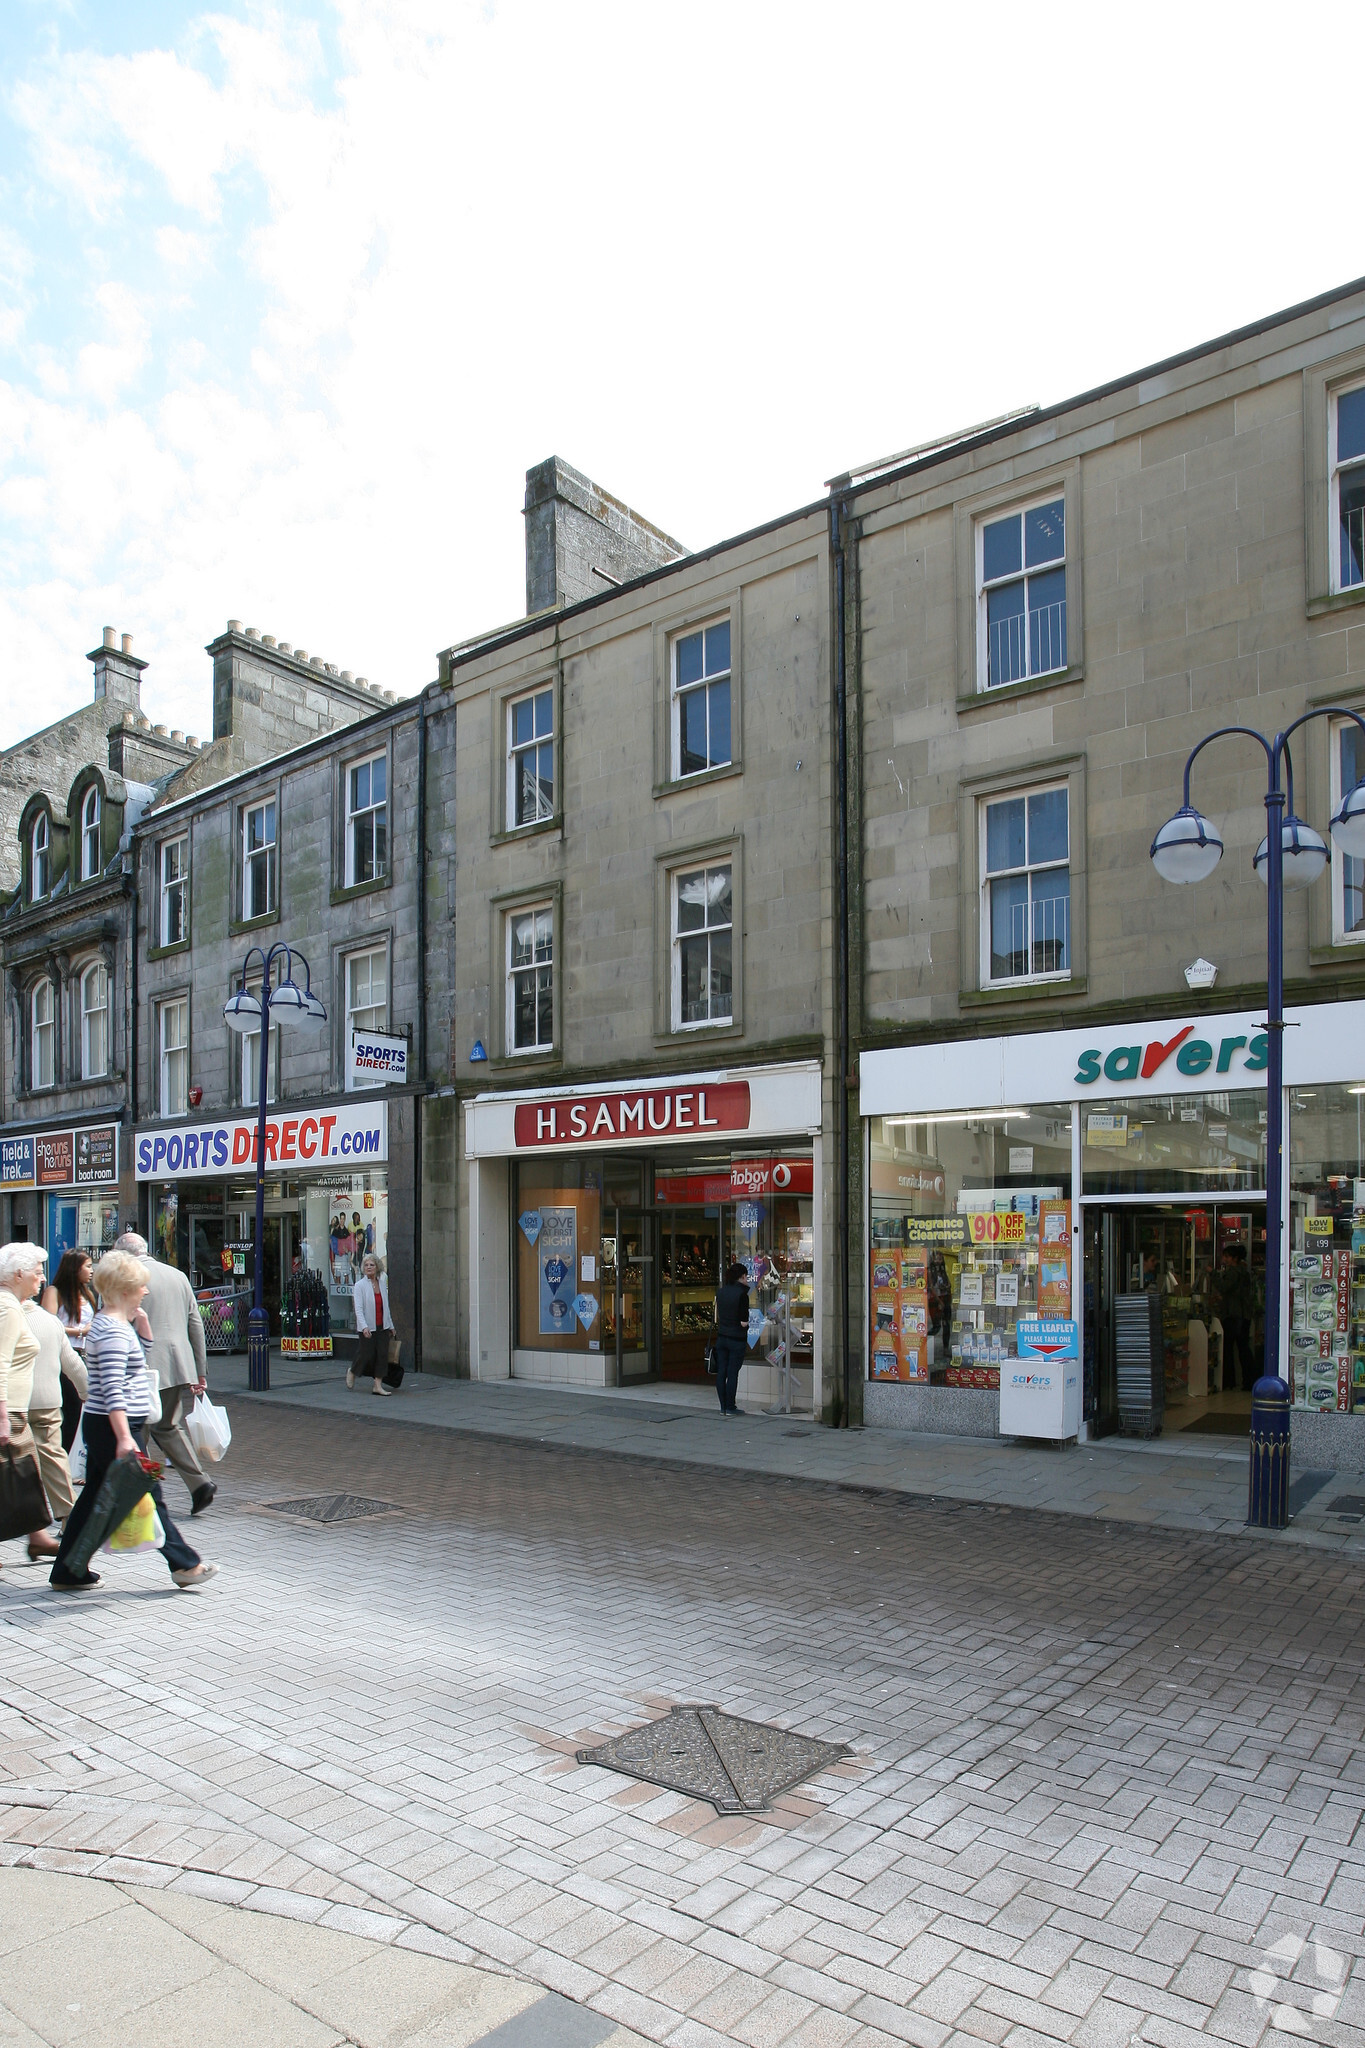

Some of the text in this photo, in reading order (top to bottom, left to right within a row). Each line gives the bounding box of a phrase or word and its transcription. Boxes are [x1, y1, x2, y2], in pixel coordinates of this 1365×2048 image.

[356, 1044, 406, 1063] SPORTS
[1074, 1025, 1268, 1084] savers
[355, 1056, 406, 1073] DIRECT.COM
[2, 1142, 30, 1162] field &
[137, 1129, 229, 1174] SPORTS
[79, 1156, 87, 1165] the
[2, 1161, 32, 1180] trek.com
[78, 1168, 112, 1181] boot room
[741, 1208, 759, 1216] LOVE
[543, 1217, 573, 1228] LOVE
[740, 1220, 759, 1228] SIGHT
[907, 1218, 964, 1231] Fragrance
[1005, 1214, 1024, 1228] OFF
[1309, 1219, 1328, 1227] LOW
[909, 1229, 965, 1241] Clearance
[1006, 1228, 1024, 1239] RRP
[542, 1236, 573, 1247] SIGHT
[1341, 1253, 1347, 1261] 6
[548, 1265, 562, 1273] LOVE
[1324, 1270, 1330, 1278] 4
[1340, 1270, 1346, 1278] 4
[1340, 1280, 1346, 1288] 6
[1340, 1296, 1346, 1304] 4
[1340, 1305, 1346, 1314] 6
[1020, 1323, 1075, 1333] FREE LEAFLET
[1339, 1322, 1345, 1330] 4
[1024, 1335, 1072, 1343] PLEASE TAKE ONE
[1322, 1332, 1328, 1341] 6
[282, 1338, 331, 1351] SALE SALE
[1322, 1348, 1328, 1357] 4
[1341, 1358, 1347, 1367] 6
[1012, 1373, 1051, 1385] savers
[1340, 1375, 1346, 1383] 4
[1340, 1386, 1346, 1394] 6
[1340, 1402, 1345, 1411] 4
